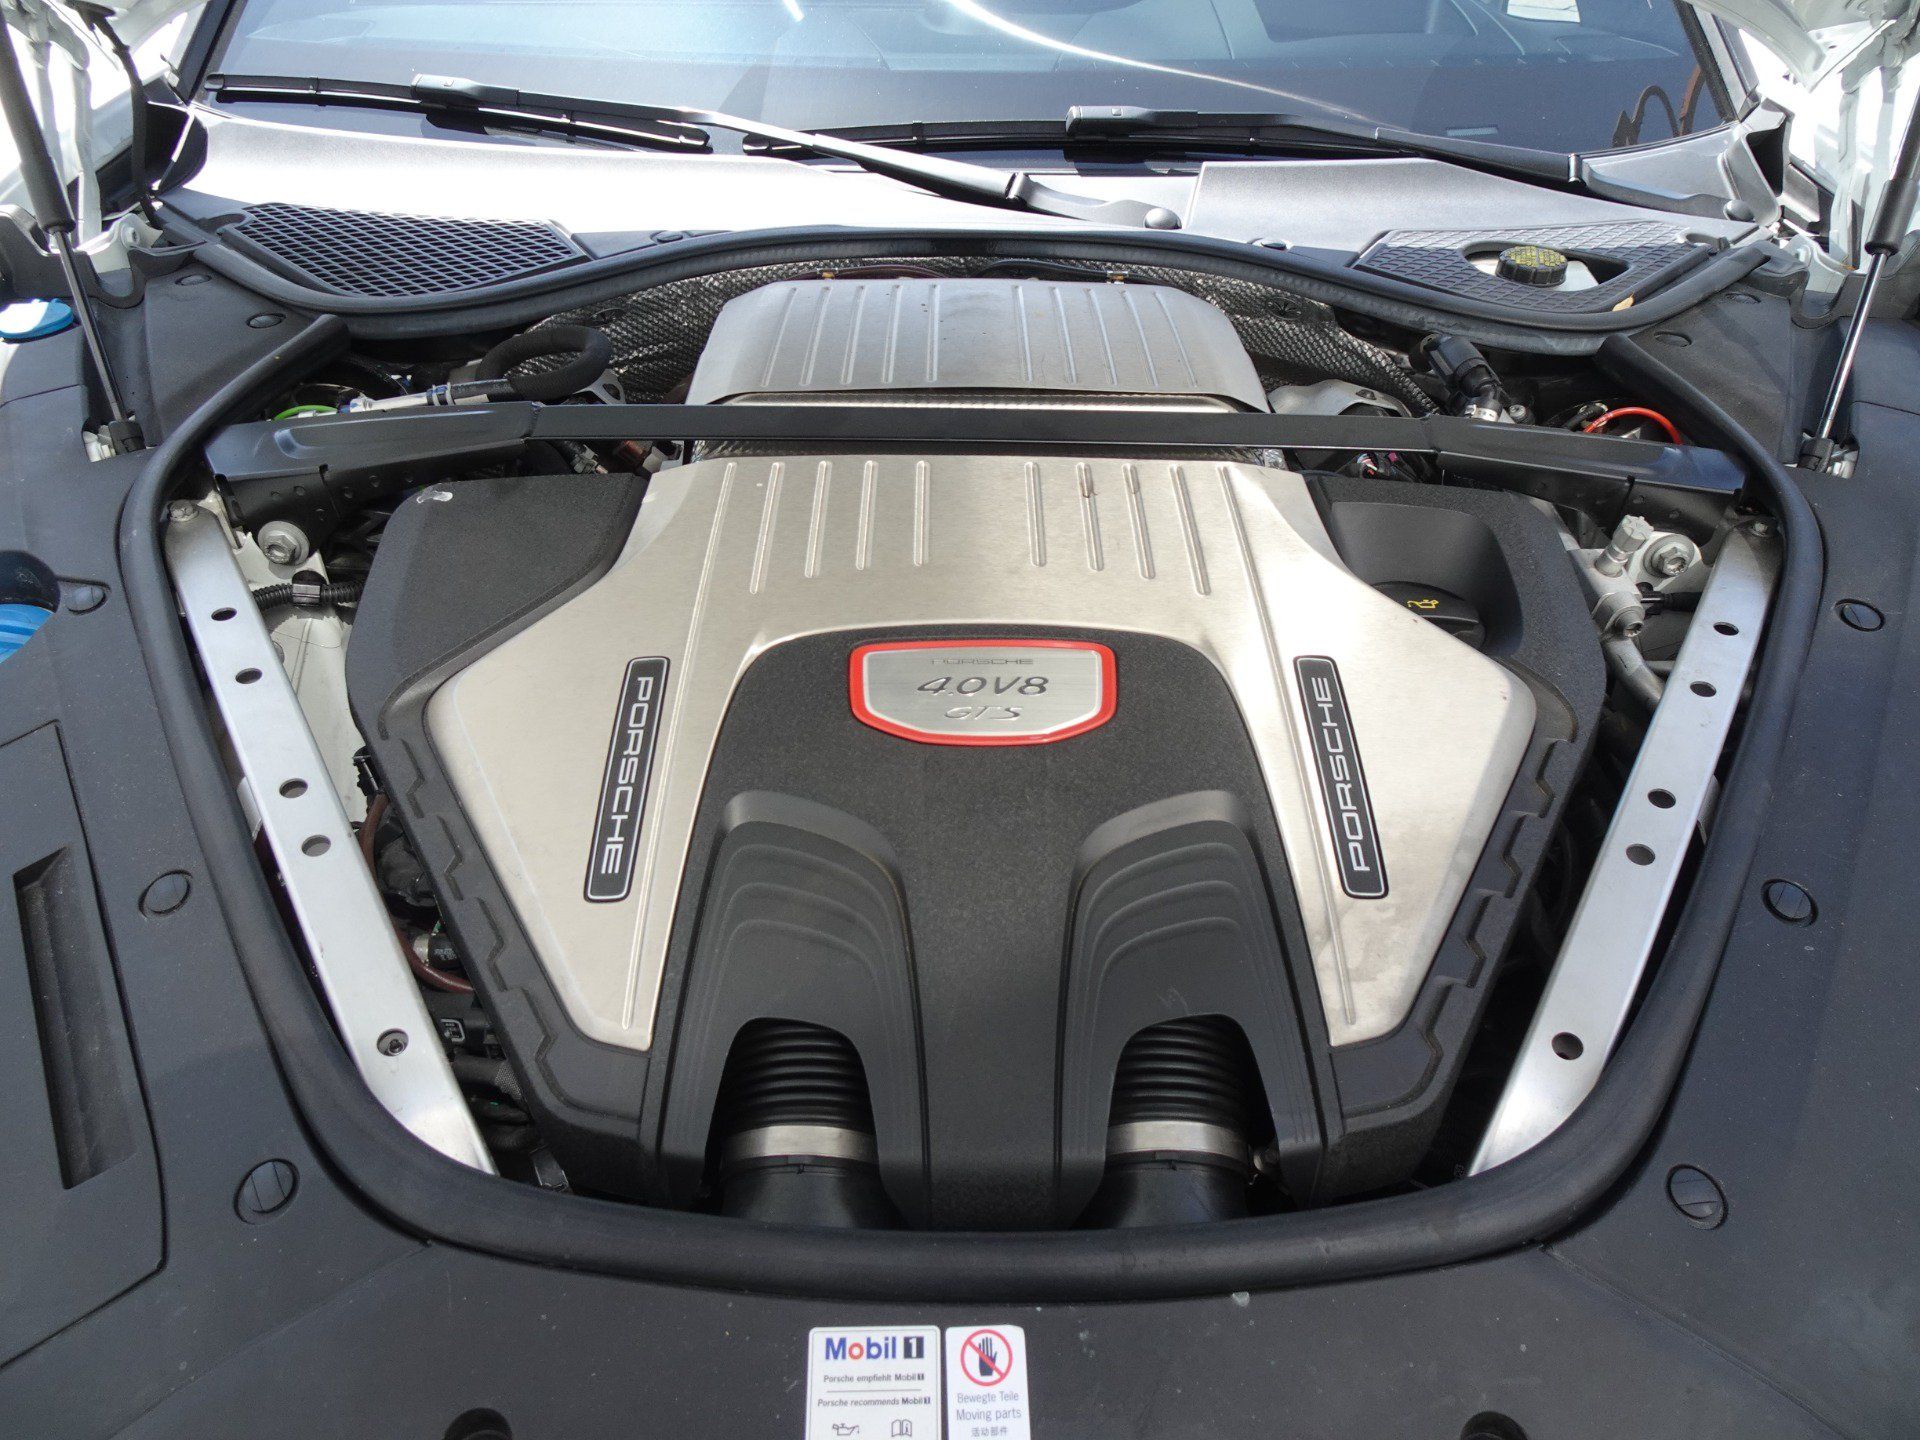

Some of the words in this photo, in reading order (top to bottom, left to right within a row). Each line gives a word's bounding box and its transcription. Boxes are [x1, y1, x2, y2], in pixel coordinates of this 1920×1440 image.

[945, 705, 1023, 720] GTS
[600, 676, 654, 875] PORSCHE
[1311, 677, 1370, 872] PORSCHE
[825, 1336, 897, 1360] Mobil
[823, 1374, 854, 1383] Porsche
[856, 1374, 892, 1383] empfiehlt
[817, 1398, 849, 1407] Porsche
[850, 1398, 900, 1407] recommends
[957, 1392, 996, 1404] Bewegte
[999, 1391, 1019, 1401] Teile
[956, 1409, 992, 1421] Moving
[995, 1408, 1022, 1420] parts
